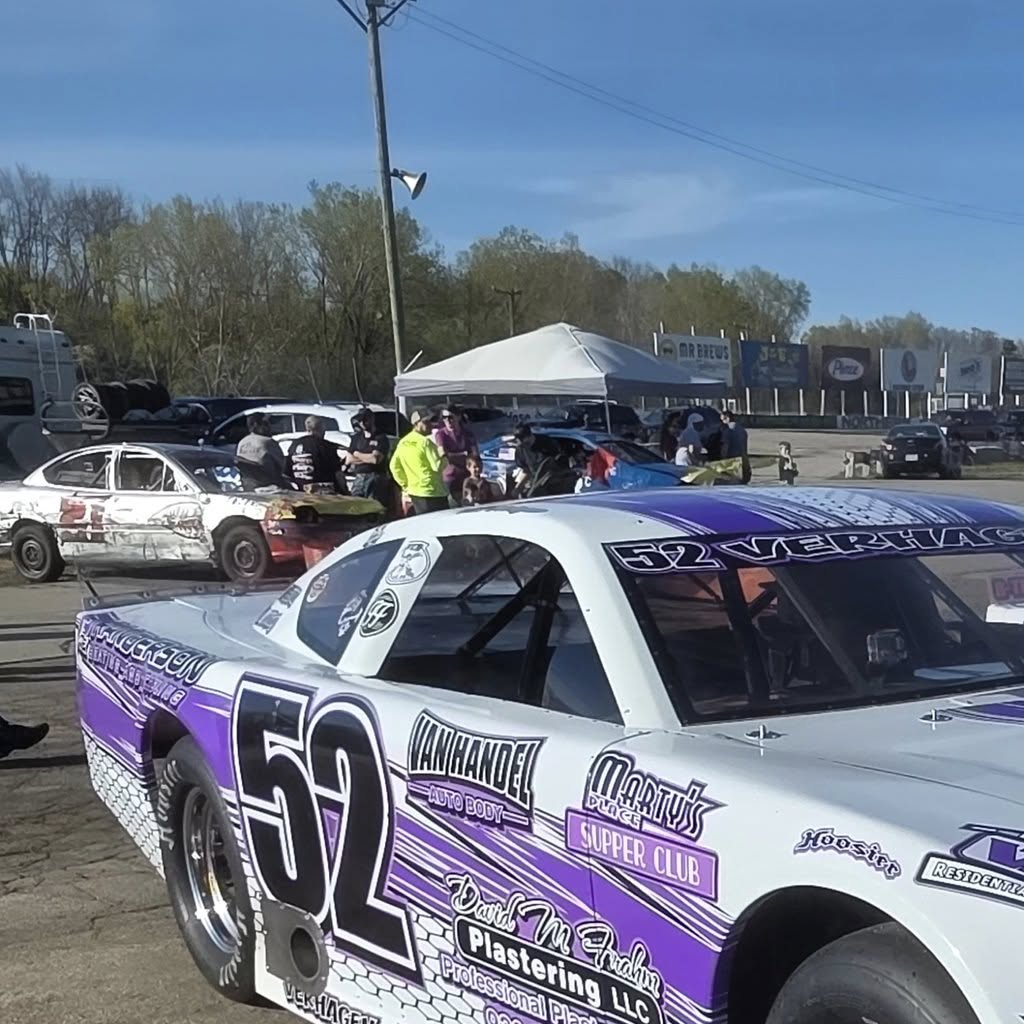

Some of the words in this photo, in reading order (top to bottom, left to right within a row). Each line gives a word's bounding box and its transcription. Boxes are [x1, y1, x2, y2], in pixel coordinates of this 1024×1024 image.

[679, 341, 694, 357] MR
[697, 344, 729, 360] BREWS
[611, 541, 719, 571] 52
[231, 674, 423, 984] 52
[428, 784, 464, 814] AUTO
[465, 794, 505, 823] BODY
[588, 795, 641, 829] PLACE
[581, 822, 646, 868] SUPPER
[653, 846, 700, 886] CLUB
[796, 830, 900, 876] Hoosier
[446, 874, 525, 931] David
[518, 900, 570, 955] M
[440, 953, 546, 1020] Professional
[468, 926, 601, 1007] Plastering
[611, 986, 652, 1023] LLC
